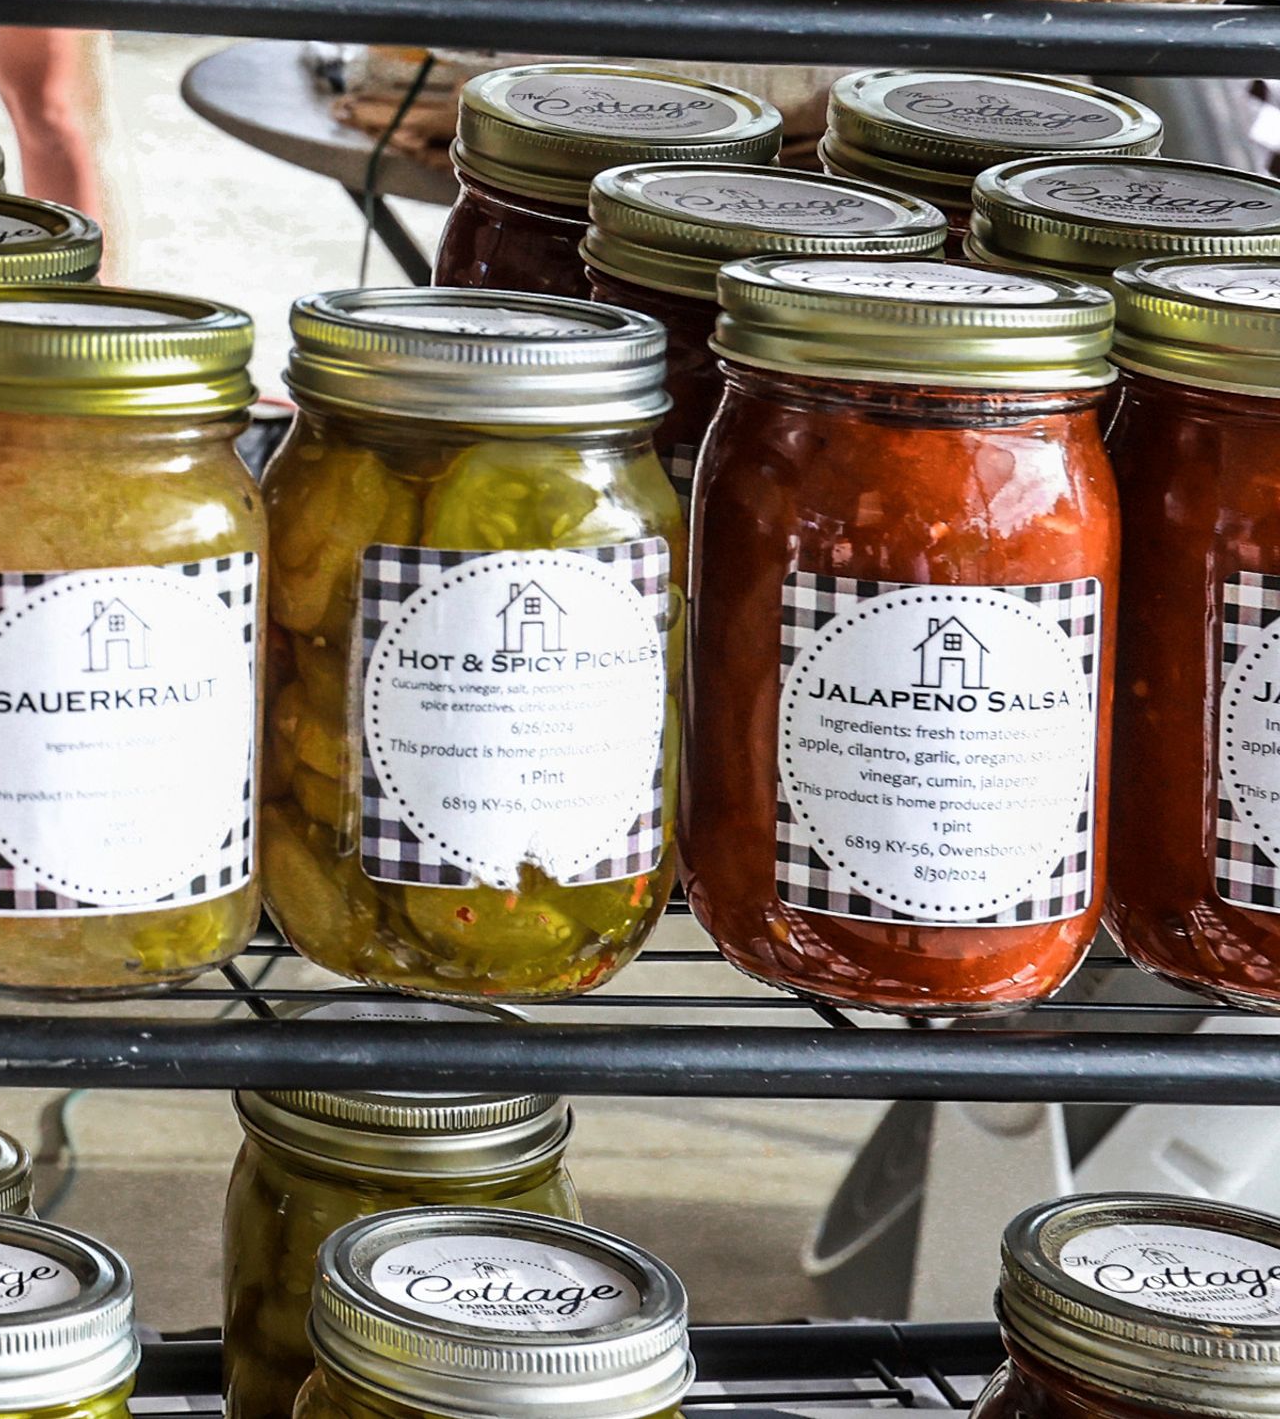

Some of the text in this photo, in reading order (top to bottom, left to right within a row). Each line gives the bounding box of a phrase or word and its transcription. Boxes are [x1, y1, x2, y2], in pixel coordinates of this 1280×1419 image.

[533, 98, 715, 118] Cottage
[905, 97, 1110, 128] Cottage
[674, 193, 864, 216] Cottage
[1046, 185, 1273, 214] Cottage
[397, 644, 659, 674] HOT & SPICY PICKLES
[391, 677, 456, 694] Cucumbers,
[459, 683, 504, 698] vinegar,
[808, 677, 1071, 713] JALAPENO SALSA
[420, 699, 448, 713] spice
[510, 720, 575, 736] 6/26/2024
[819, 714, 912, 738] Ingredients:
[915, 724, 955, 740] fresh
[390, 738, 418, 755] This
[420, 742, 478, 759] product
[482, 745, 493, 758] is
[496, 745, 536, 758] home
[798, 735, 843, 757] apple,
[847, 743, 910, 764] cilantro,
[914, 750, 961, 767] garlic,
[520, 770, 566, 785] 1 Pint
[859, 769, 977, 790] vinegar, cumin,
[796, 781, 822, 796] This
[825, 787, 879, 805] product
[882, 793, 893, 806] is
[896, 795, 936, 810] home
[940, 797, 1002, 813] produced
[1239, 783, 1267, 799] This
[441, 795, 477, 814] 6819
[481, 797, 527, 814] KY-56,
[932, 819, 972, 836] 1 pint
[844, 834, 881, 854] 6819
[885, 839, 934, 858] KY-56,
[913, 864, 987, 883] 8/30/2024
[387, 1264, 428, 1276] The
[1063, 1255, 1104, 1268] The
[405, 1275, 623, 1316] Cottage
